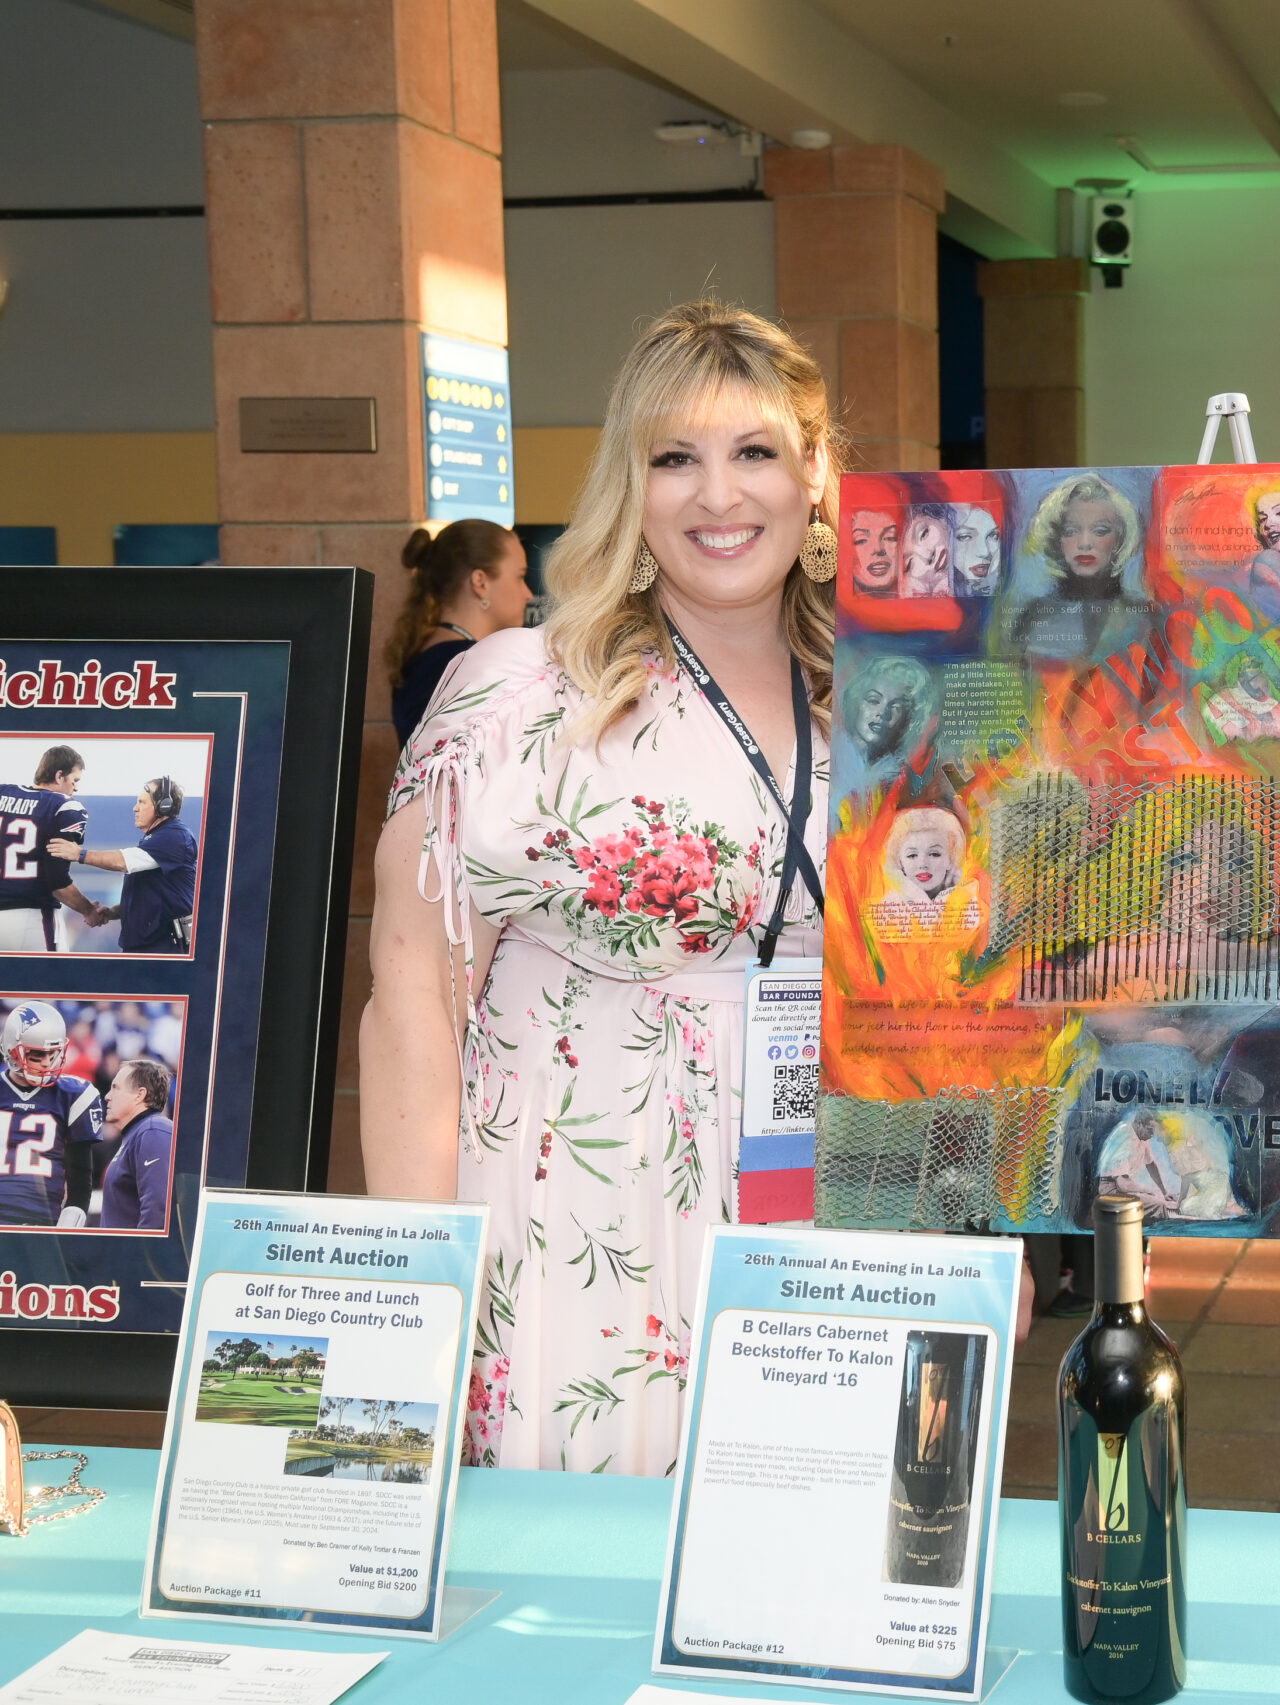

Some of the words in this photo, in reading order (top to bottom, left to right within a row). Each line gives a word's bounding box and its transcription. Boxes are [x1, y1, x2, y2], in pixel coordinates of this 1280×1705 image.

[1125, 605, 1155, 615] equal
[671, 634, 702, 678] CaseyGerry
[717, 702, 752, 749] CaseyGerry
[755, 1004, 772, 1012] Scan
[774, 1003, 785, 1011] the
[787, 1004, 799, 1012] QR
[801, 1003, 817, 1011] code
[233, 1219, 262, 1231] 26th
[265, 1221, 309, 1233] Annual
[311, 1223, 328, 1234] An
[332, 1224, 384, 1240] Evening
[386, 1226, 398, 1238] in
[401, 1228, 417, 1239] La
[420, 1229, 450, 1241] Jolla
[266, 1244, 325, 1263] Silent
[329, 1247, 408, 1268] Auction
[744, 1253, 775, 1266] 26th
[779, 1256, 827, 1269] Annual
[830, 1259, 848, 1270] An
[852, 1260, 907, 1276] Evening
[910, 1263, 923, 1275] in
[927, 1264, 944, 1276] La
[948, 1265, 980, 1278] Jolla
[245, 1283, 275, 1297] Golf
[278, 1284, 297, 1298] for
[301, 1286, 340, 1301] Three
[344, 1290, 372, 1303] and
[376, 1290, 419, 1306] Lunch
[780, 1280, 845, 1301] Silent
[850, 1284, 936, 1306] Auction
[235, 1305, 250, 1318] at
[254, 1305, 280, 1320] San
[285, 1307, 326, 1325] Diego
[330, 1310, 387, 1329] Country
[391, 1314, 423, 1329] Club
[742, 1319, 753, 1333] B
[758, 1320, 811, 1337] Cellars
[817, 1324, 888, 1342] Cabernet
[732, 1342, 823, 1361] Beckstoffer
[827, 1348, 844, 1363] To
[849, 1350, 893, 1366] Kalon
[762, 1367, 828, 1386] Vineyard
[1087, 1533, 1093, 1542] B
[1095, 1534, 1142, 1544] CELLARS
[349, 1564, 373, 1574] Value
[375, 1567, 385, 1575] at
[386, 1566, 418, 1578] $1,200
[170, 1583, 201, 1593] Auction
[204, 1585, 242, 1598] Package
[245, 1589, 261, 1598] #11
[339, 1577, 375, 1590] Opening
[377, 1580, 392, 1589] Bid
[394, 1581, 417, 1592] $200
[1100, 1582, 1112, 1592] To
[1113, 1582, 1138, 1592] Kalon
[1140, 1573, 1171, 1590] Vineyard
[884, 1594, 910, 1603] Donated
[911, 1596, 920, 1605] by:
[921, 1597, 937, 1605] Allen
[938, 1599, 960, 1607] Snyder
[1081, 1602, 1111, 1614] cabernet
[1113, 1605, 1152, 1616] sauvignon
[890, 1621, 917, 1632] Value
[919, 1624, 929, 1633] at
[932, 1624, 957, 1636] $225
[684, 1636, 720, 1648] Auction
[723, 1640, 763, 1653] Package
[766, 1644, 784, 1654] #12
[876, 1635, 915, 1648] Opening
[918, 1639, 934, 1648] Bid
[937, 1640, 956, 1651] $75
[1093, 1642, 1112, 1650] NAPA
[1113, 1643, 1139, 1651] VALLEY
